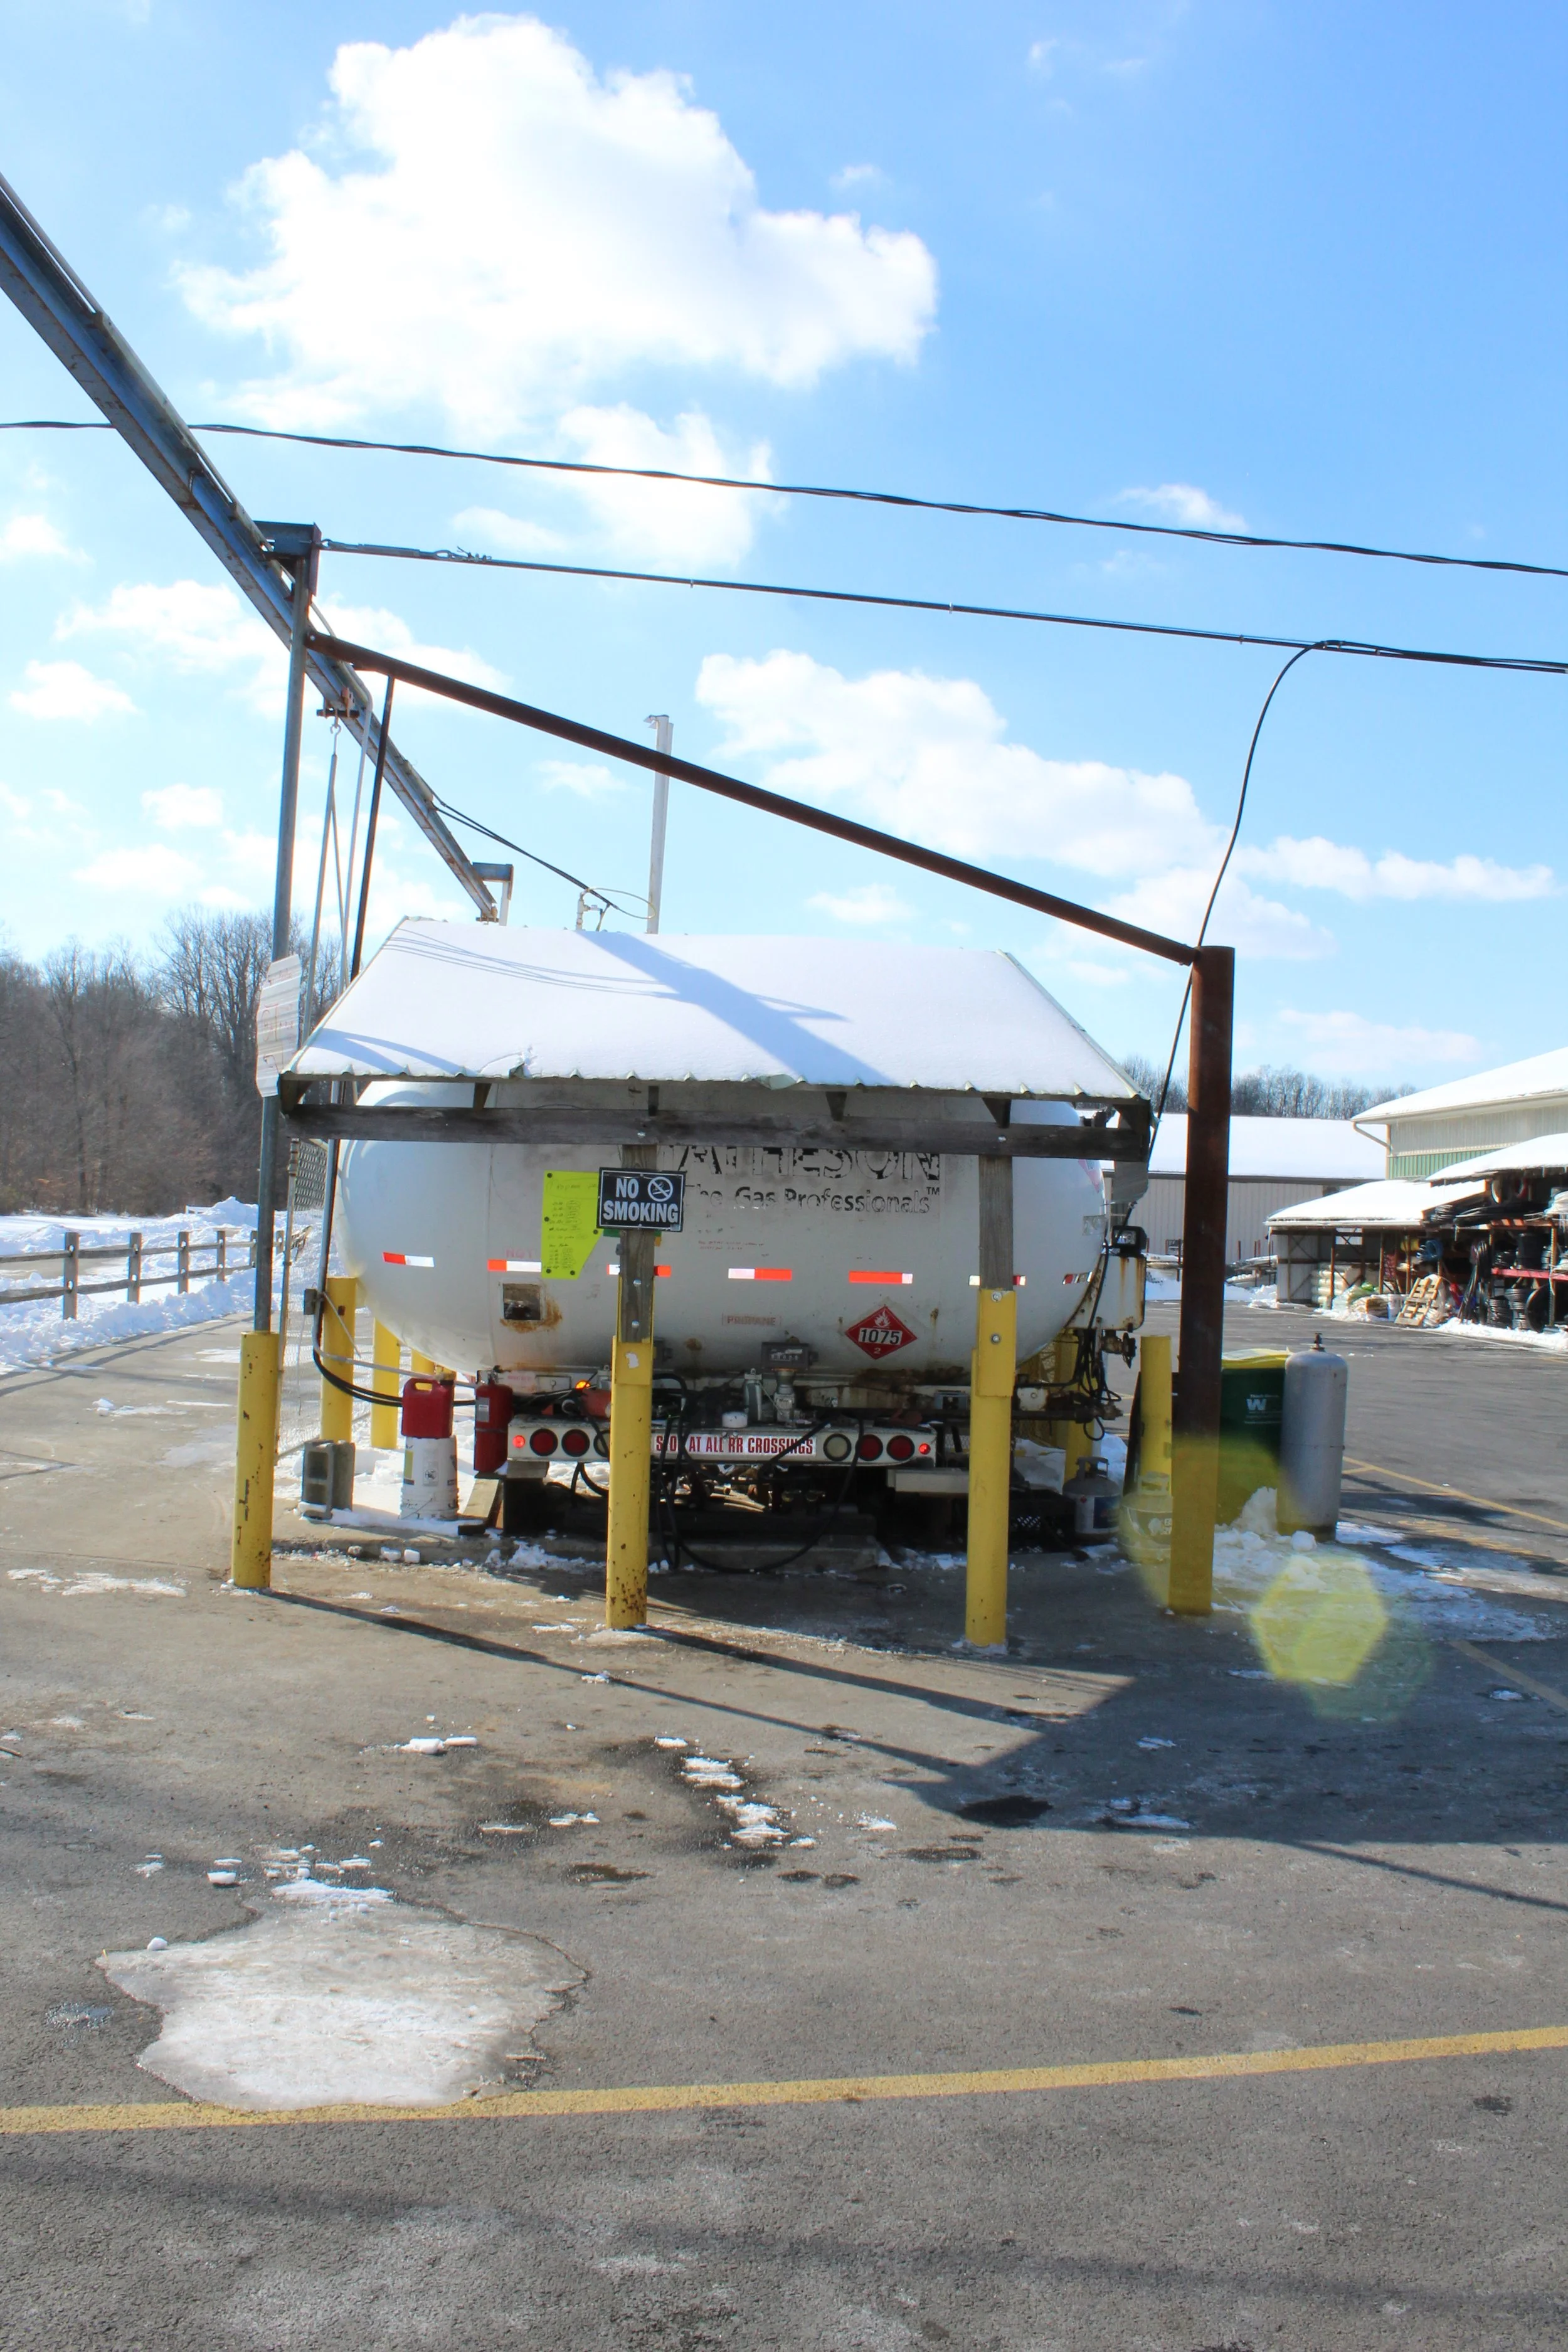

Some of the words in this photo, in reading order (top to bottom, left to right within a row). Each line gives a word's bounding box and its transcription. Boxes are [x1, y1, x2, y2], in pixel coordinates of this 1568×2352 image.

[662, 1146, 940, 1180] ATHESON
[616, 1177, 639, 1199] NO
[735, 1186, 779, 1207] Gas
[785, 1188, 930, 1214] Professionals
[603, 1200, 679, 1223] SMOKING
[861, 1329, 899, 1345] 1075
[689, 1436, 702, 1452] AT
[706, 1436, 724, 1453] ALL
[728, 1437, 743, 1453] RR
[748, 1437, 813, 1454] CROSSINGS
